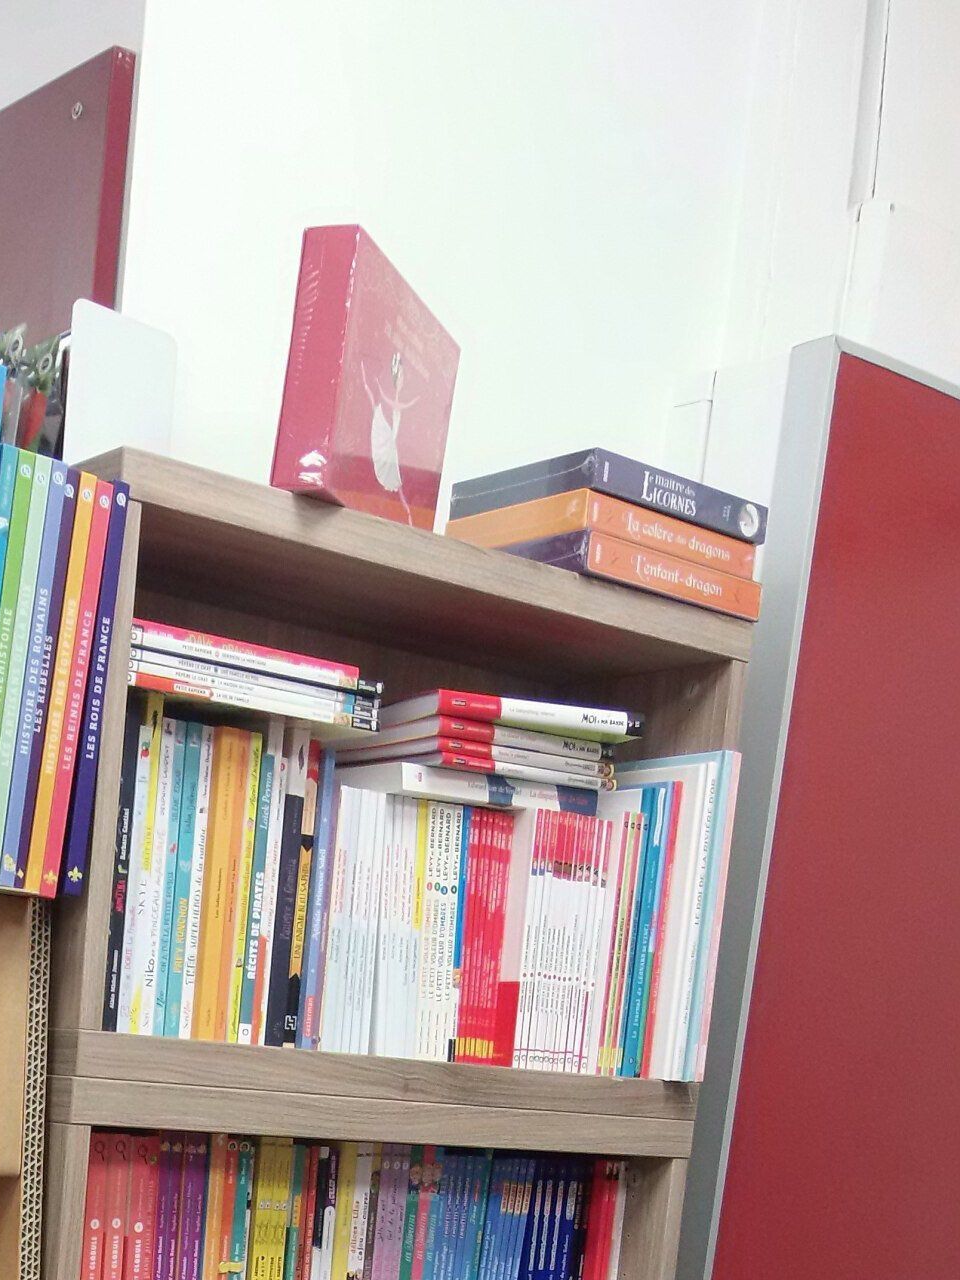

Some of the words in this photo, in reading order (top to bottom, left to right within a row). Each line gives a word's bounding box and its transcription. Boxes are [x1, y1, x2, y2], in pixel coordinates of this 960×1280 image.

[641, 474, 697, 517] LICORNES
[32, 587, 49, 654] ROMAINS
[77, 609, 93, 666] FRANCE
[96, 615, 111, 674] FRANCE
[28, 658, 39, 685] DES
[37, 634, 54, 705] REBELLES
[73, 673, 84, 694] DE
[93, 675, 104, 695] DE
[20, 689, 36, 755] HISTOIRE
[33, 706, 43, 733] LES
[65, 694, 80, 743] REINES
[90, 698, 101, 732] ROIS
[63, 745, 72, 771] LES
[85, 734, 96, 760] LES
[253, 871, 265, 918] PIRATES
[251, 919, 260, 938] DE
[247, 942, 259, 980] RÉCITS
